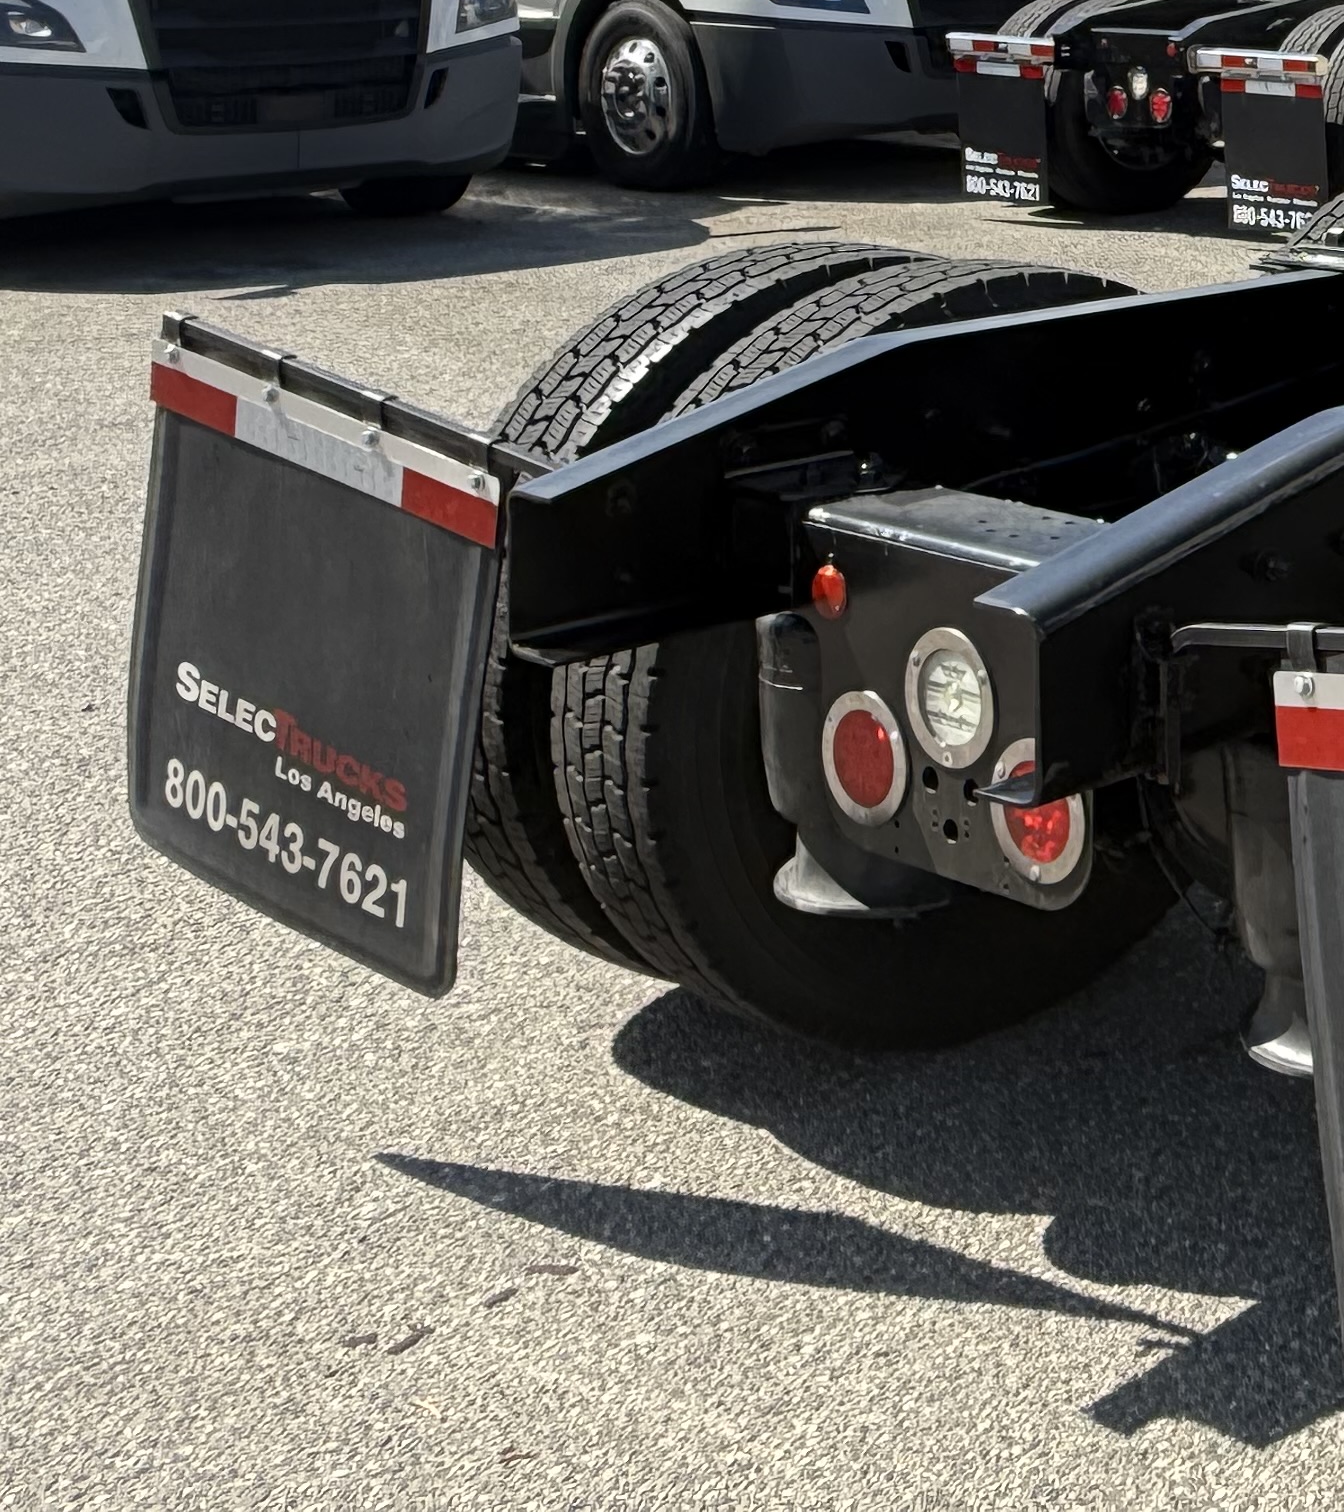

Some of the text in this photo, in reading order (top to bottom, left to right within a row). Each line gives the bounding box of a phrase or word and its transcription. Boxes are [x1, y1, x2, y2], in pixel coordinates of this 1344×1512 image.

[175, 661, 408, 812] SELECTRUCKS
[275, 756, 405, 839] Los Angeles
[164, 758, 407, 928] 800-543-7621
